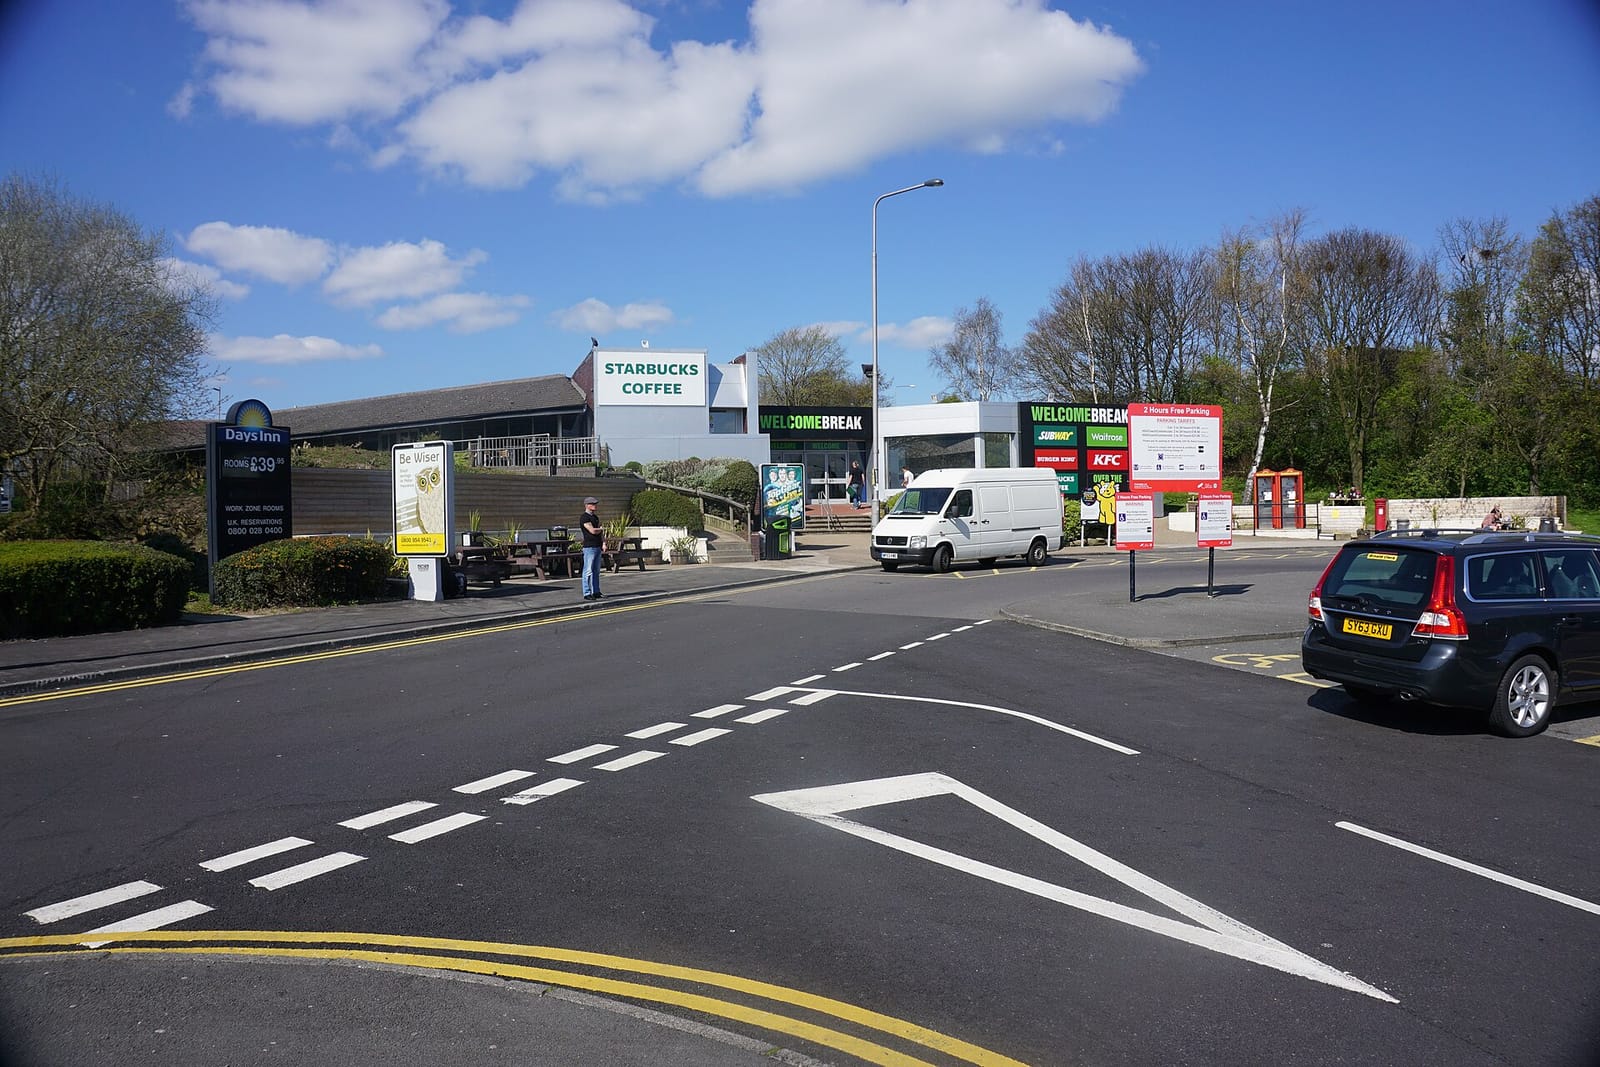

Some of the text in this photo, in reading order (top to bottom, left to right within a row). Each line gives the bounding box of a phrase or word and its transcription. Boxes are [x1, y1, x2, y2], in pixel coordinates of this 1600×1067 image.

[604, 363, 699, 376] STARBUCKS
[622, 382, 682, 394] COFFEE
[1143, 406, 1149, 414] 2
[1186, 408, 1210, 416] Parking
[225, 429, 281, 442] Days Inn
[1038, 431, 1074, 441] SUBWAY
[1091, 432, 1123, 442] Waitrose
[399, 450, 440, 465] Be Wiser
[1093, 454, 1121, 466] KFC
[224, 459, 250, 468] ROOMS
[1093, 474, 1123, 483] OVER THE
[240, 518, 283, 526] RESERVATIONS
[227, 526, 283, 535] 0800 028 0400
[1347, 619, 1389, 637] SY63 GXU
